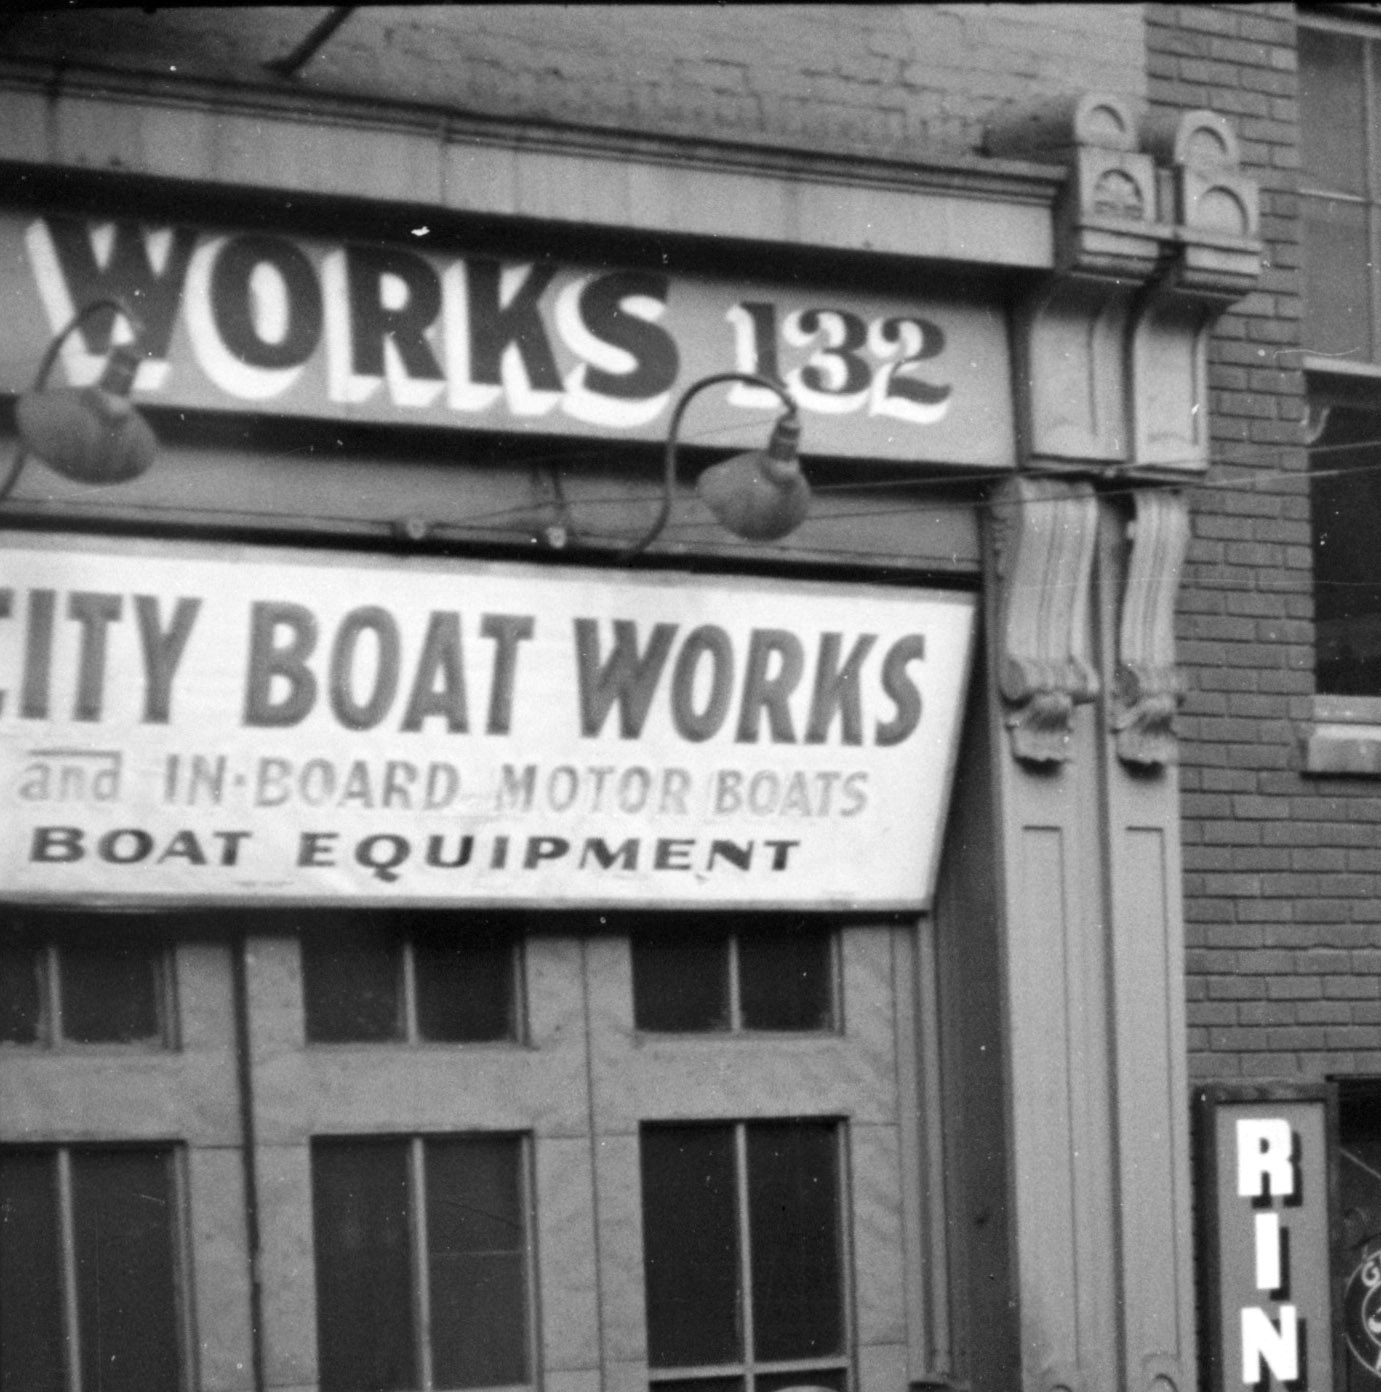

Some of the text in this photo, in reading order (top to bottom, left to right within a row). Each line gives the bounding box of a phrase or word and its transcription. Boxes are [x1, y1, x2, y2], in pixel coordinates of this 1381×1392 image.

[27, 217, 952, 428] WORKS 132
[0, 588, 926, 747] ITY BOAT WORKS
[19, 749, 123, 802] and
[496, 763, 692, 815] MOTOR
[714, 768, 870, 817] BOATS
[28, 826, 801, 882] BOAT EQUIPMENT
